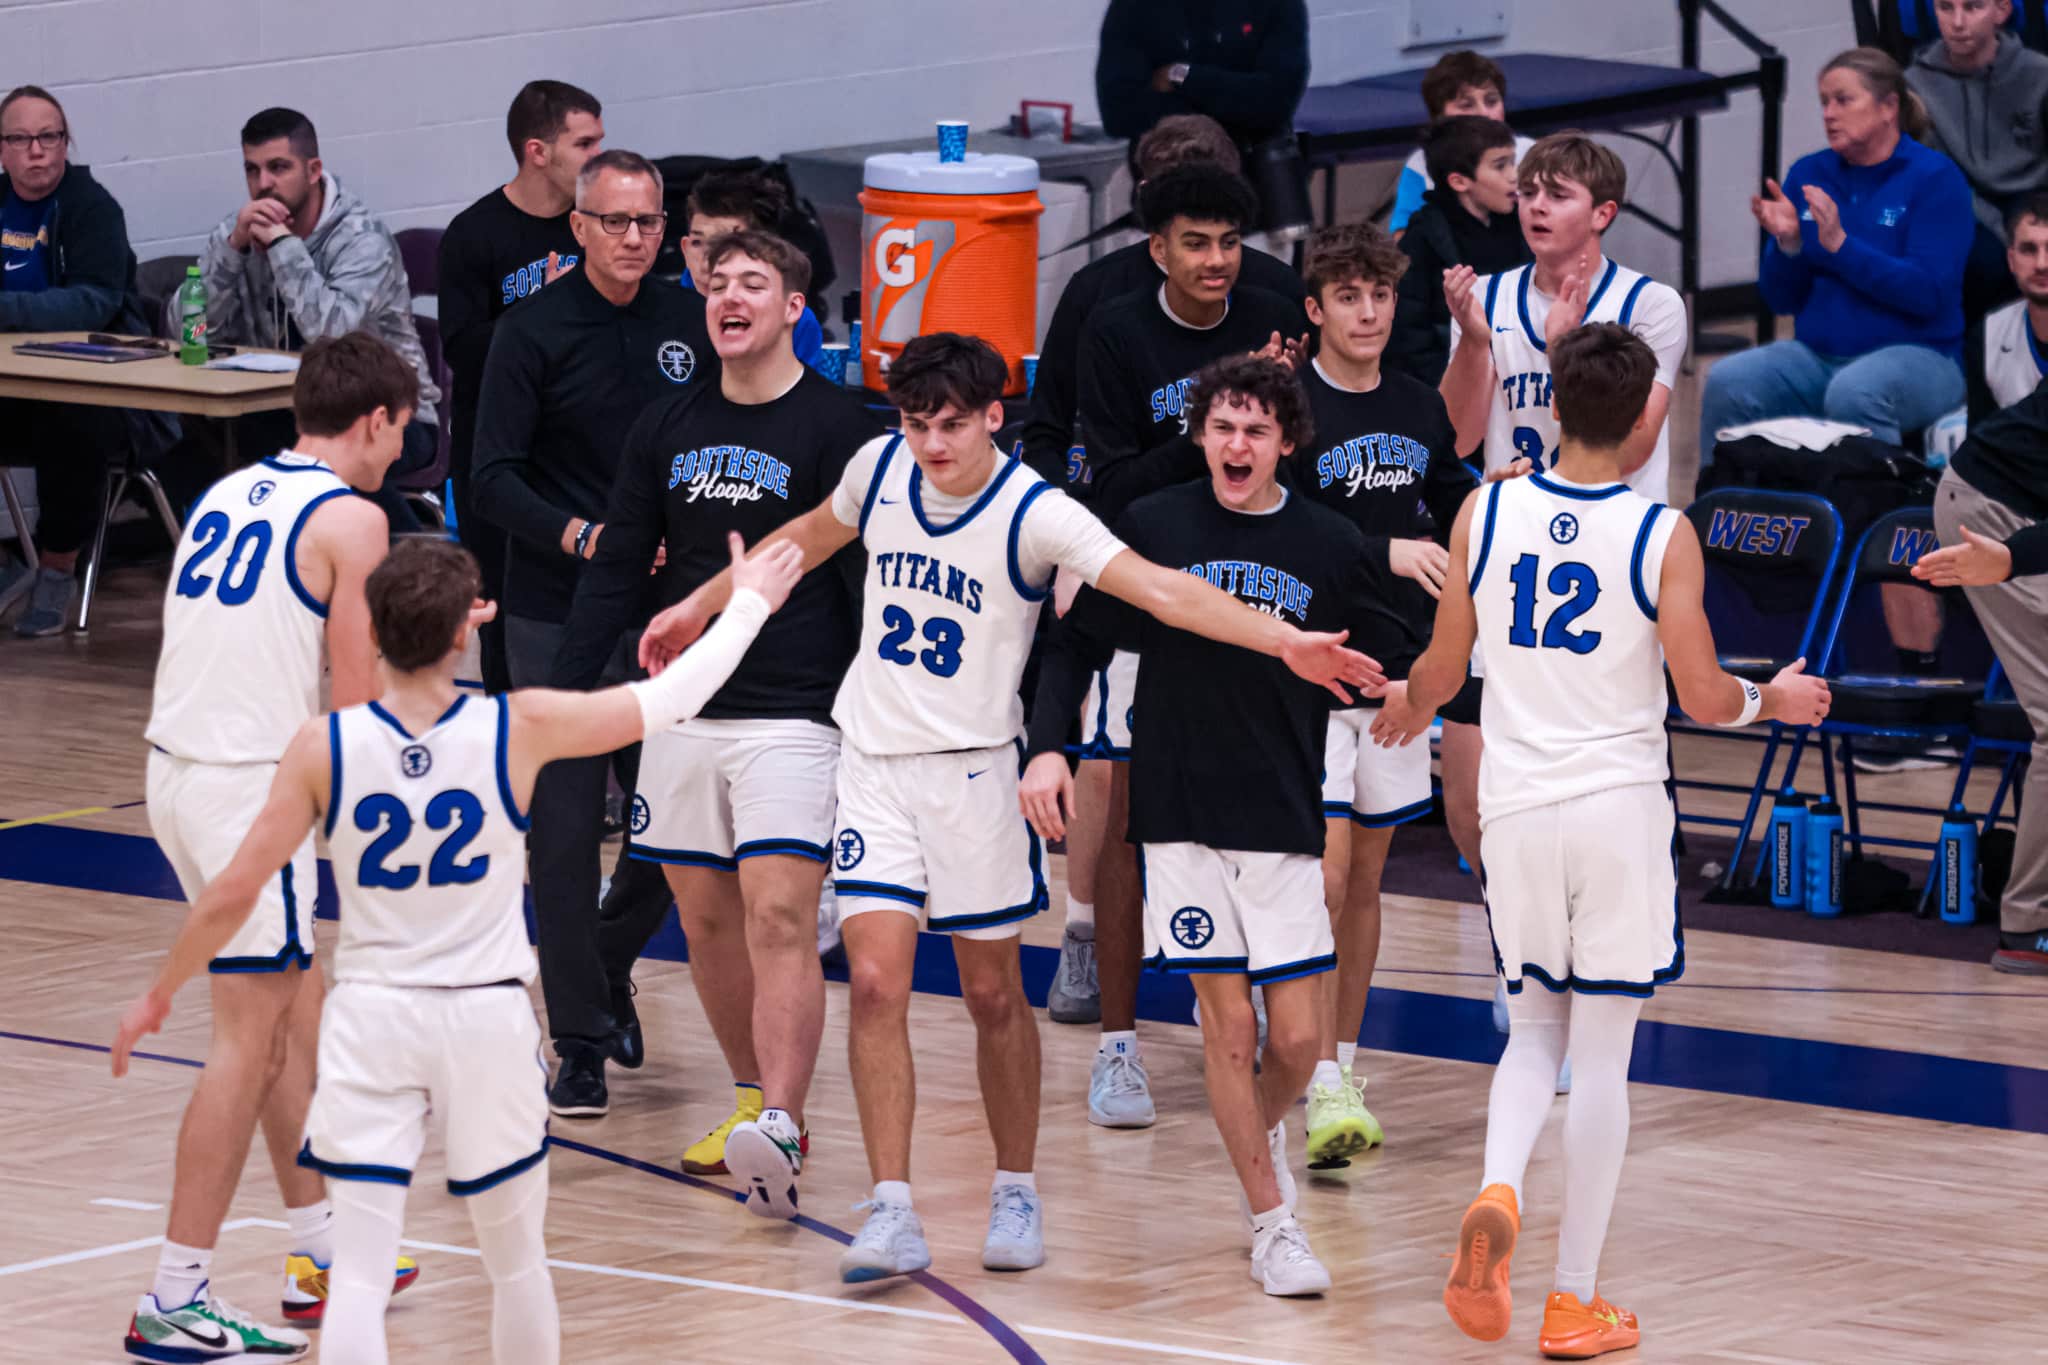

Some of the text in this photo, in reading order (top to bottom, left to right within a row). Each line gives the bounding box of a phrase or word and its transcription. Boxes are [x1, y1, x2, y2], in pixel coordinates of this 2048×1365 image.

[876, 228, 915, 287] G
[668, 445, 791, 499] SOUTHSIDE
[1317, 432, 1430, 489] SOUTHSIDE
[1345, 462, 1415, 498] Hoops
[1511, 426, 1560, 474] 3
[686, 471, 763, 507] Hoops
[176, 510, 273, 606] 20
[1706, 508, 1811, 556] WEST
[877, 552, 983, 615] TITANS
[1182, 560, 1313, 621] UTHSIDE
[1509, 552, 1602, 655] 12
[878, 604, 966, 679] 23
[354, 789, 491, 892] 22
[1777, 824, 1789, 896] POWERADE
[1947, 839, 1958, 912] POWERADE
